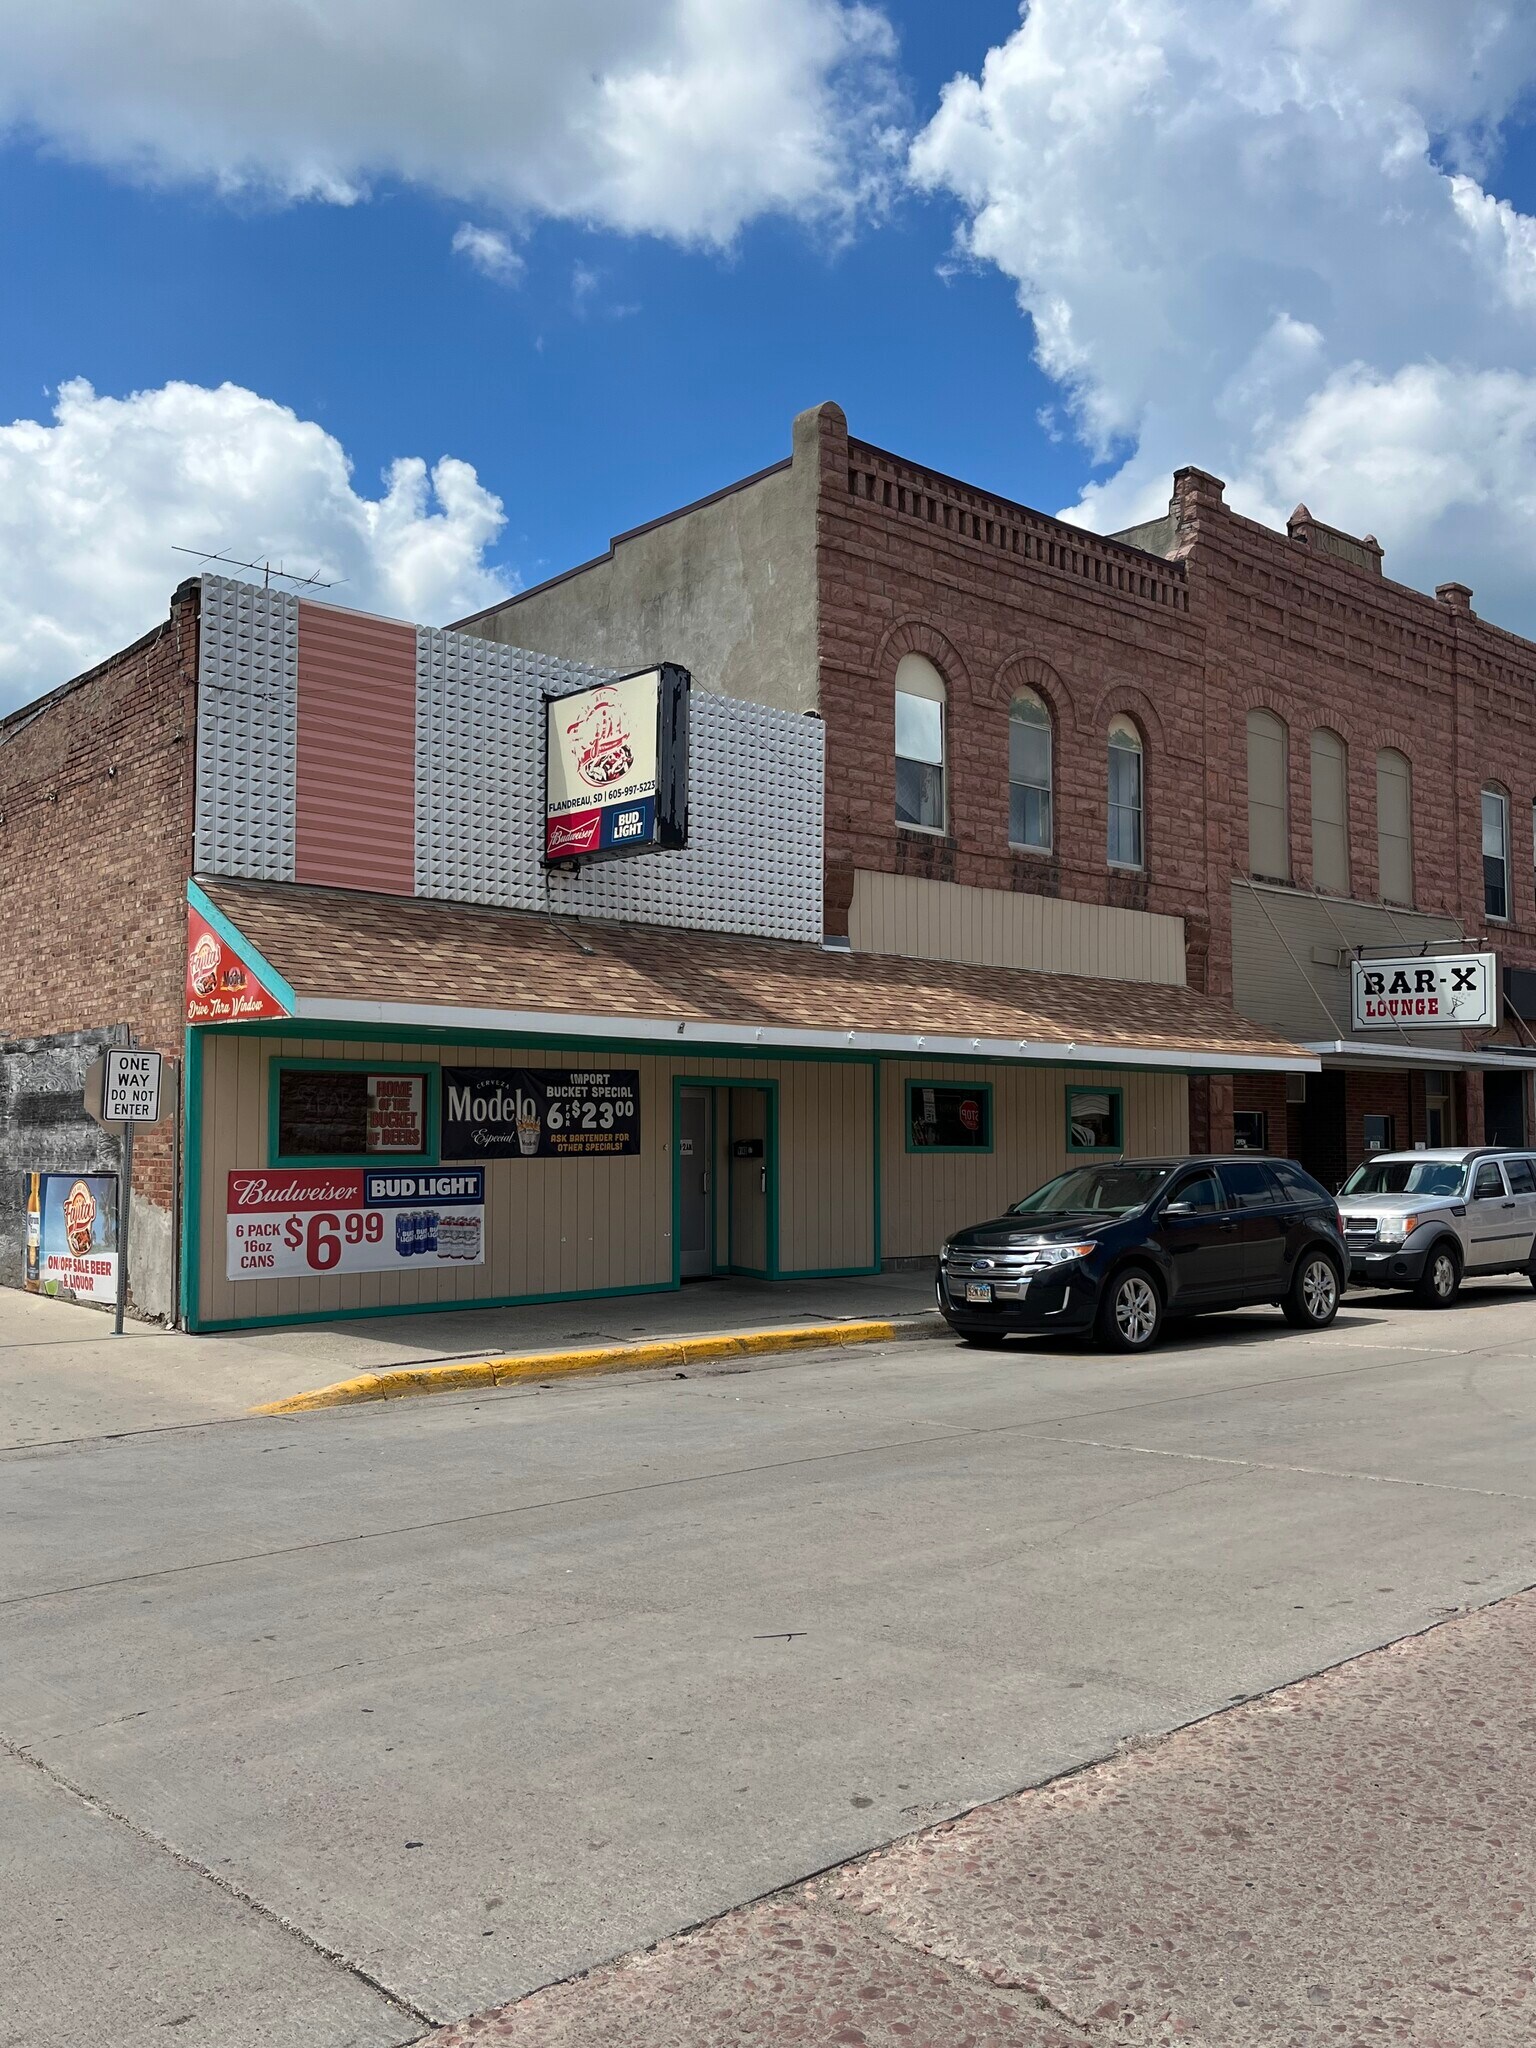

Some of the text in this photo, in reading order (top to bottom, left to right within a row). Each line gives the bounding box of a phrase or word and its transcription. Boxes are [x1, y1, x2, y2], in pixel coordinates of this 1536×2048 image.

[549, 796, 592, 812] FLANDREAU,
[593, 793, 603, 804] SD
[608, 781, 656, 799] 605-997-5223
[618, 811, 639, 826] BUD
[550, 828, 594, 846] Budweiser
[613, 822, 643, 838] LIGHT
[1363, 967, 1477, 995] BAR-X
[188, 995, 263, 1019] Drive Thru Window
[1366, 998, 1439, 1017] LOUNGE
[119, 1057, 150, 1071] ONE
[118, 1073, 150, 1087] WAY
[476, 1079, 510, 1090] CERVEZA
[570, 1073, 611, 1085] IMPORT
[111, 1089, 154, 1101] DO NOT
[376, 1081, 412, 1098] HOME
[546, 1086, 633, 1098] BUCKET SPECIAL
[114, 1103, 149, 1115] ENTER
[378, 1098, 392, 1110] OF
[447, 1086, 536, 1122] Modelo
[370, 1111, 417, 1128] BUCKET
[546, 1102, 564, 1130] 6
[381, 1129, 420, 1145] BEERS
[550, 1133, 630, 1143] ASK BARTENDER FOR
[557, 1142, 623, 1152] OTHER SPECIALS!
[233, 1177, 477, 1205] Budweiser BUD LIGHT
[236, 1223, 281, 1237] 6 PACK
[243, 1240, 272, 1252] 16oz
[73, 1258, 88, 1274] SALE
[90, 1260, 112, 1276] BEER
[240, 1255, 275, 1269] CANS
[63, 1273, 94, 1291] & LIQUOR
